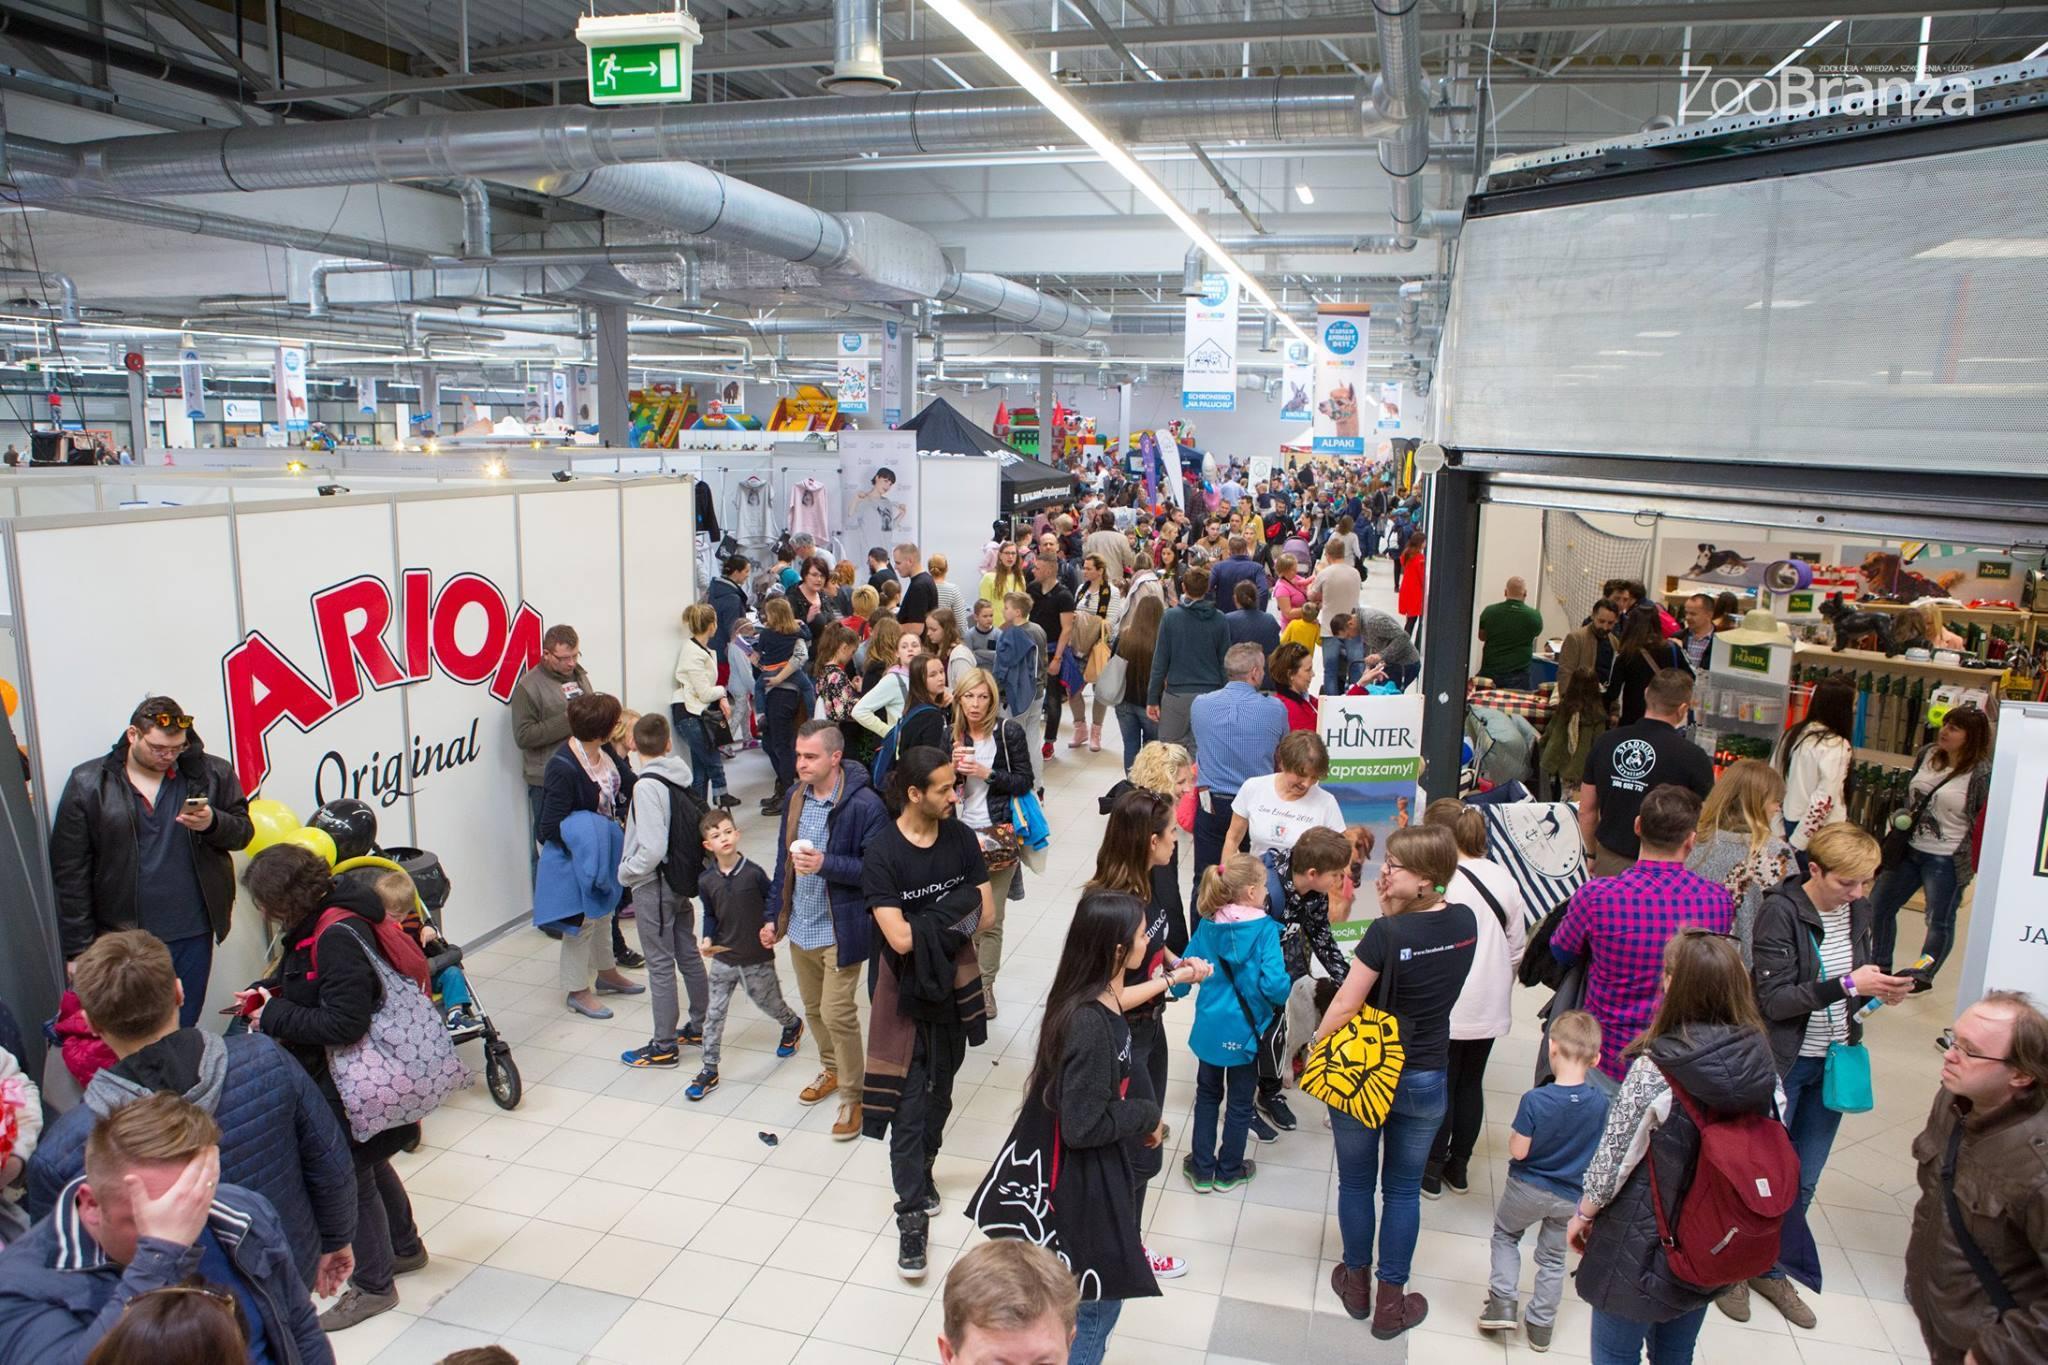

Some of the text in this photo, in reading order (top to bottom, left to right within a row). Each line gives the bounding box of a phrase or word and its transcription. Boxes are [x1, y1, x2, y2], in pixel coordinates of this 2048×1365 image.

[1321, 438, 1356, 448] ALPAKI
[1734, 653, 1766, 667] HUNTER
[1326, 727, 1415, 749] HUNTER
[1616, 741, 1654, 762] STADNINA
[314, 717, 482, 808] Original
[1328, 761, 1415, 780] apraszamy!
